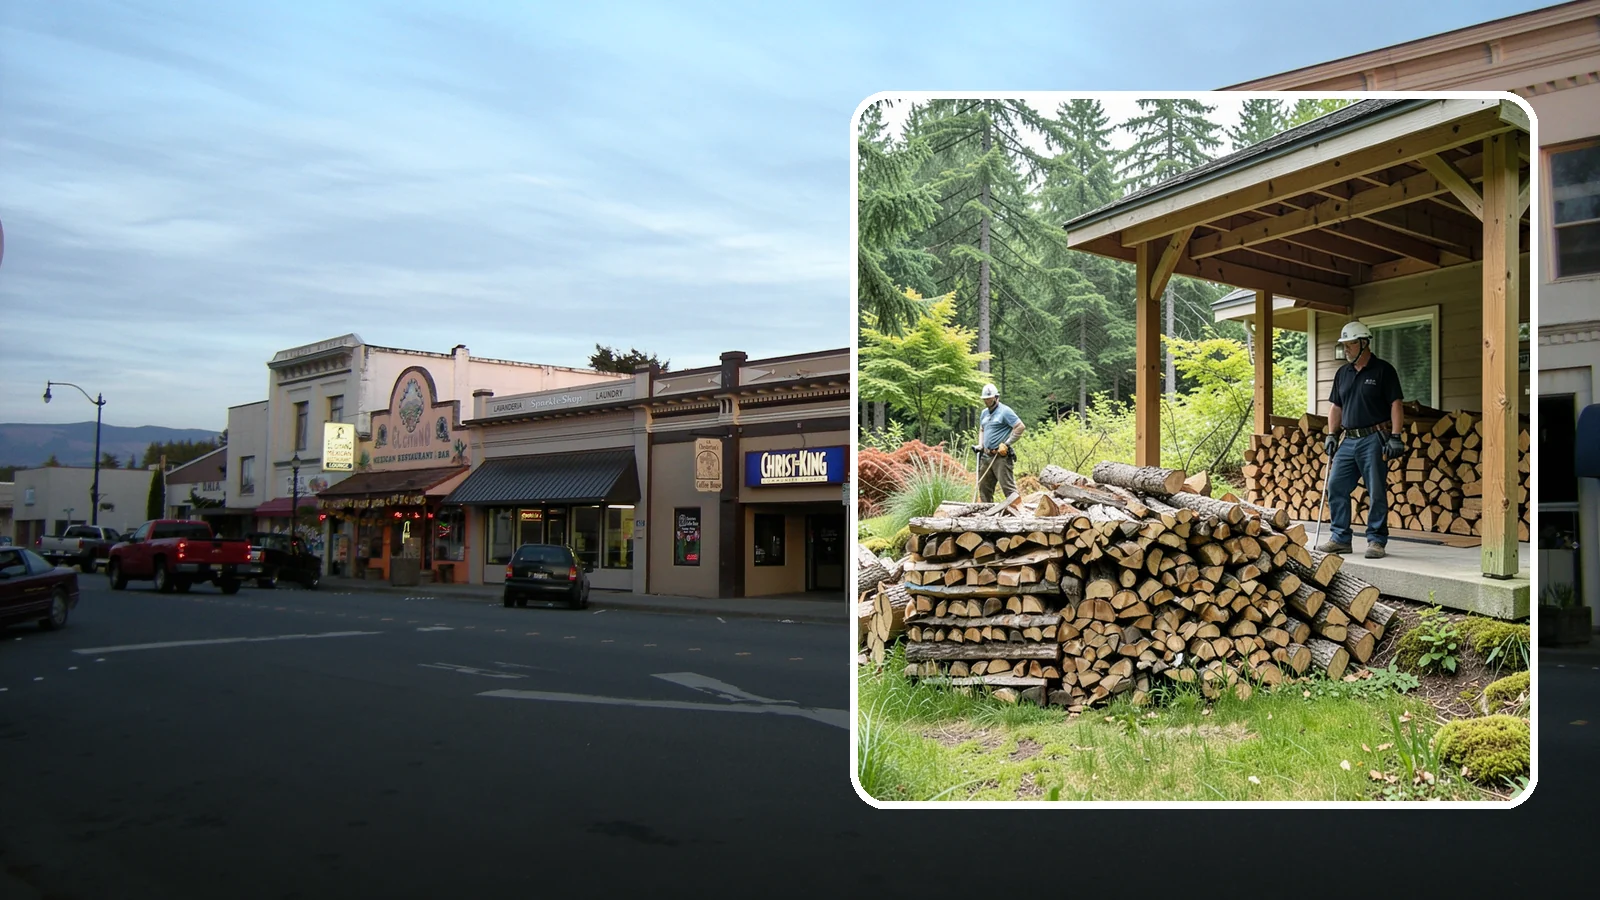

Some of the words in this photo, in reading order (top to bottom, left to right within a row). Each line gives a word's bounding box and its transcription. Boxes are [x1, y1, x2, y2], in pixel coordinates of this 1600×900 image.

[493, 402, 522, 412] LAVANDERIA
[530, 396, 561, 408] Sparkle
[561, 394, 582, 405] Shop
[595, 389, 623, 400] LAUNDRY
[373, 455, 396, 464] MEXICAN
[397, 451, 433, 462] RESTAURANT
[438, 450, 450, 459] BAR
[799, 449, 827, 477] KING
